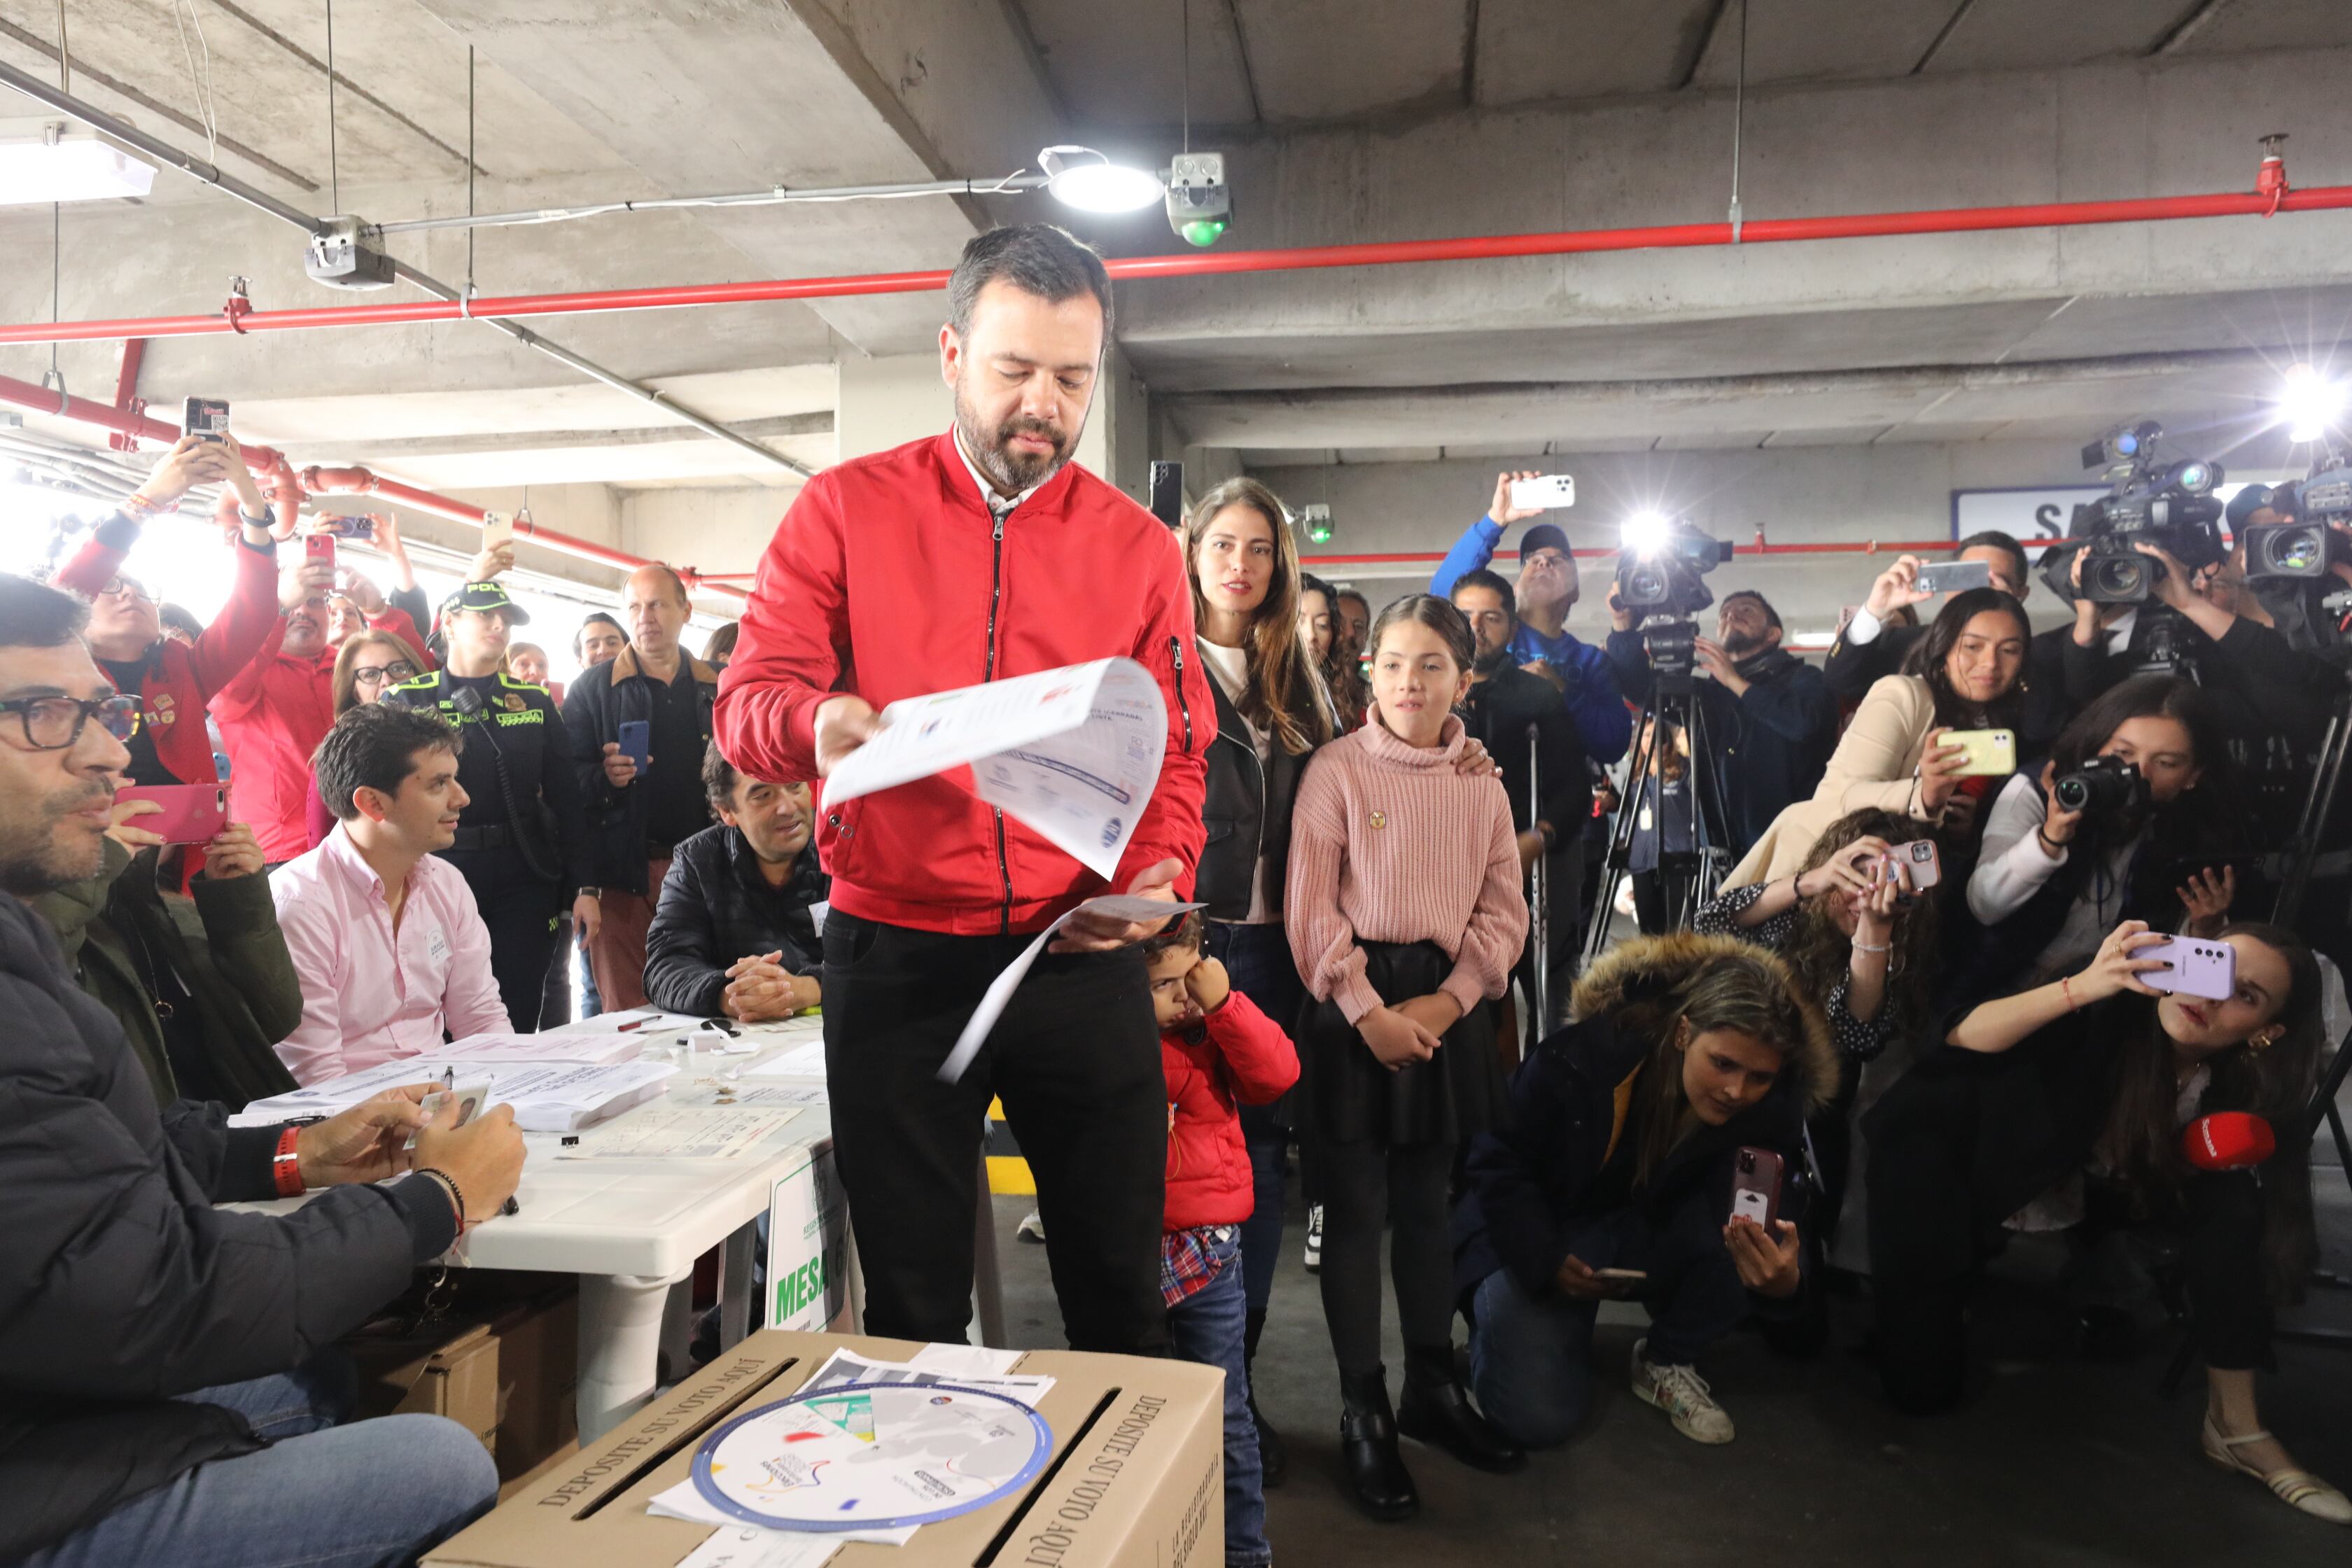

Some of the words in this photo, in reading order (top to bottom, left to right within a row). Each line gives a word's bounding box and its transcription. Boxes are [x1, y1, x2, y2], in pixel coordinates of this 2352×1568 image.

[2202, 1118, 2218, 1158] Semana
[775, 1248, 830, 1326] MESA
[538, 1436, 654, 1507] DEPOSITE
[640, 1417, 680, 1435] SU
[678, 1385, 726, 1415] VOTO
[1101, 1394, 1167, 1457] DEPOSITE
[1088, 1455, 1124, 1478] SU
[1058, 1479, 1111, 1521] VOTO
[1172, 1530, 1179, 1554] LA
[1184, 1517, 1198, 1563] SIGLO
